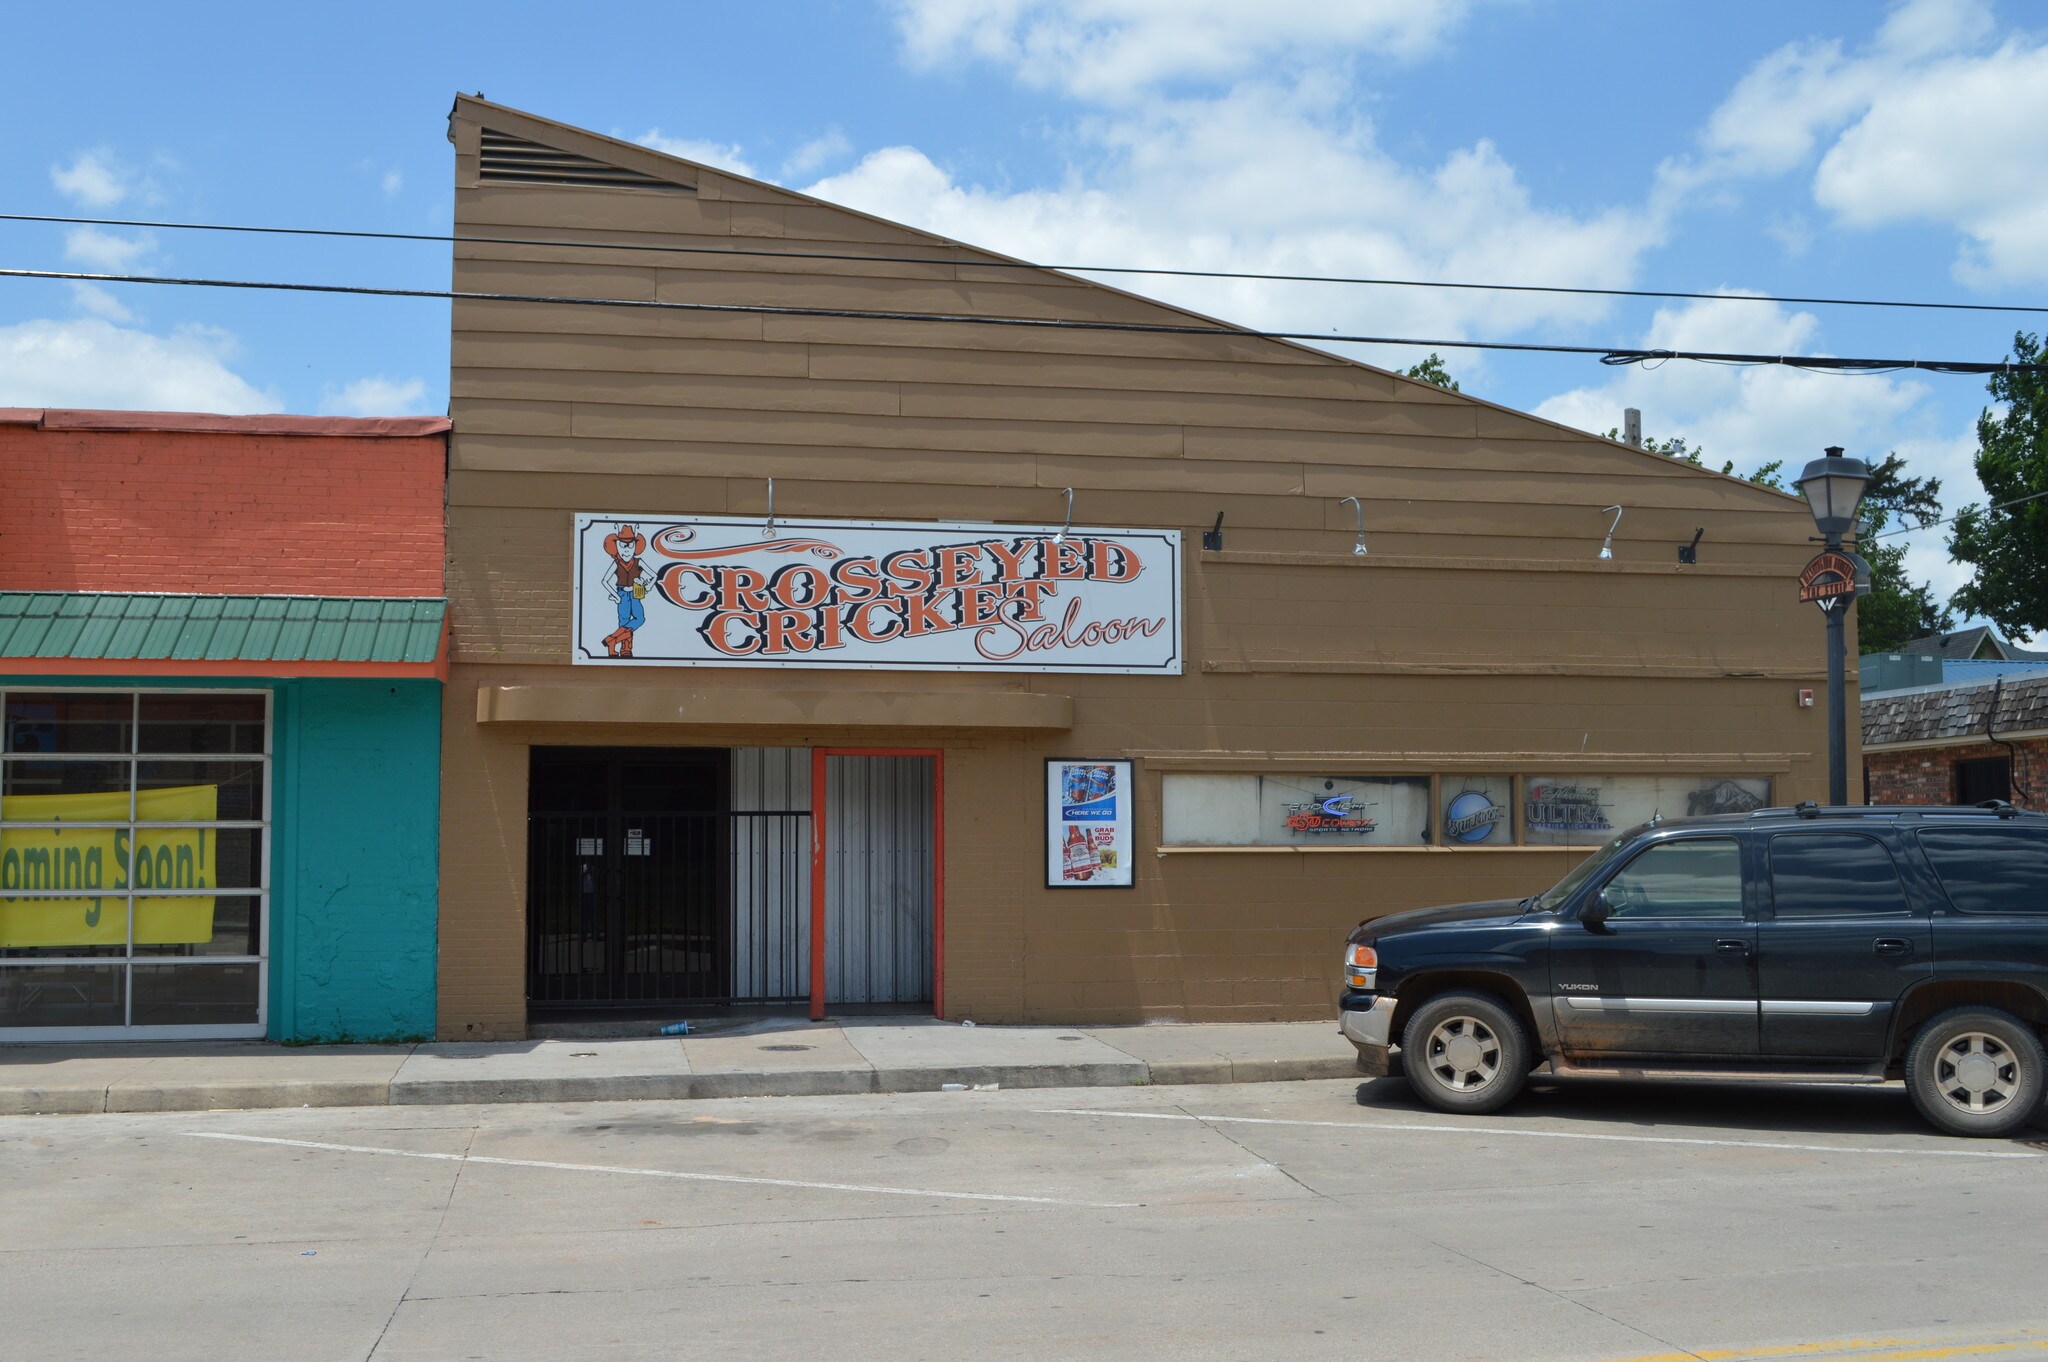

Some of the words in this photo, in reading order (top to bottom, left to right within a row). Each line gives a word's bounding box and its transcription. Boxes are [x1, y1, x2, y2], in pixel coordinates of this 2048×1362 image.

[655, 537, 1145, 612] CROSSEYED
[697, 579, 1059, 656] CRICKET
[975, 595, 1166, 661] Saloon
[1289, 802, 1321, 811] BUD
[1329, 802, 1371, 810] LIGHT
[1528, 803, 1608, 823] ULTRA
[2, 815, 102, 928] oming
[1558, 983, 1599, 991] YUKON
